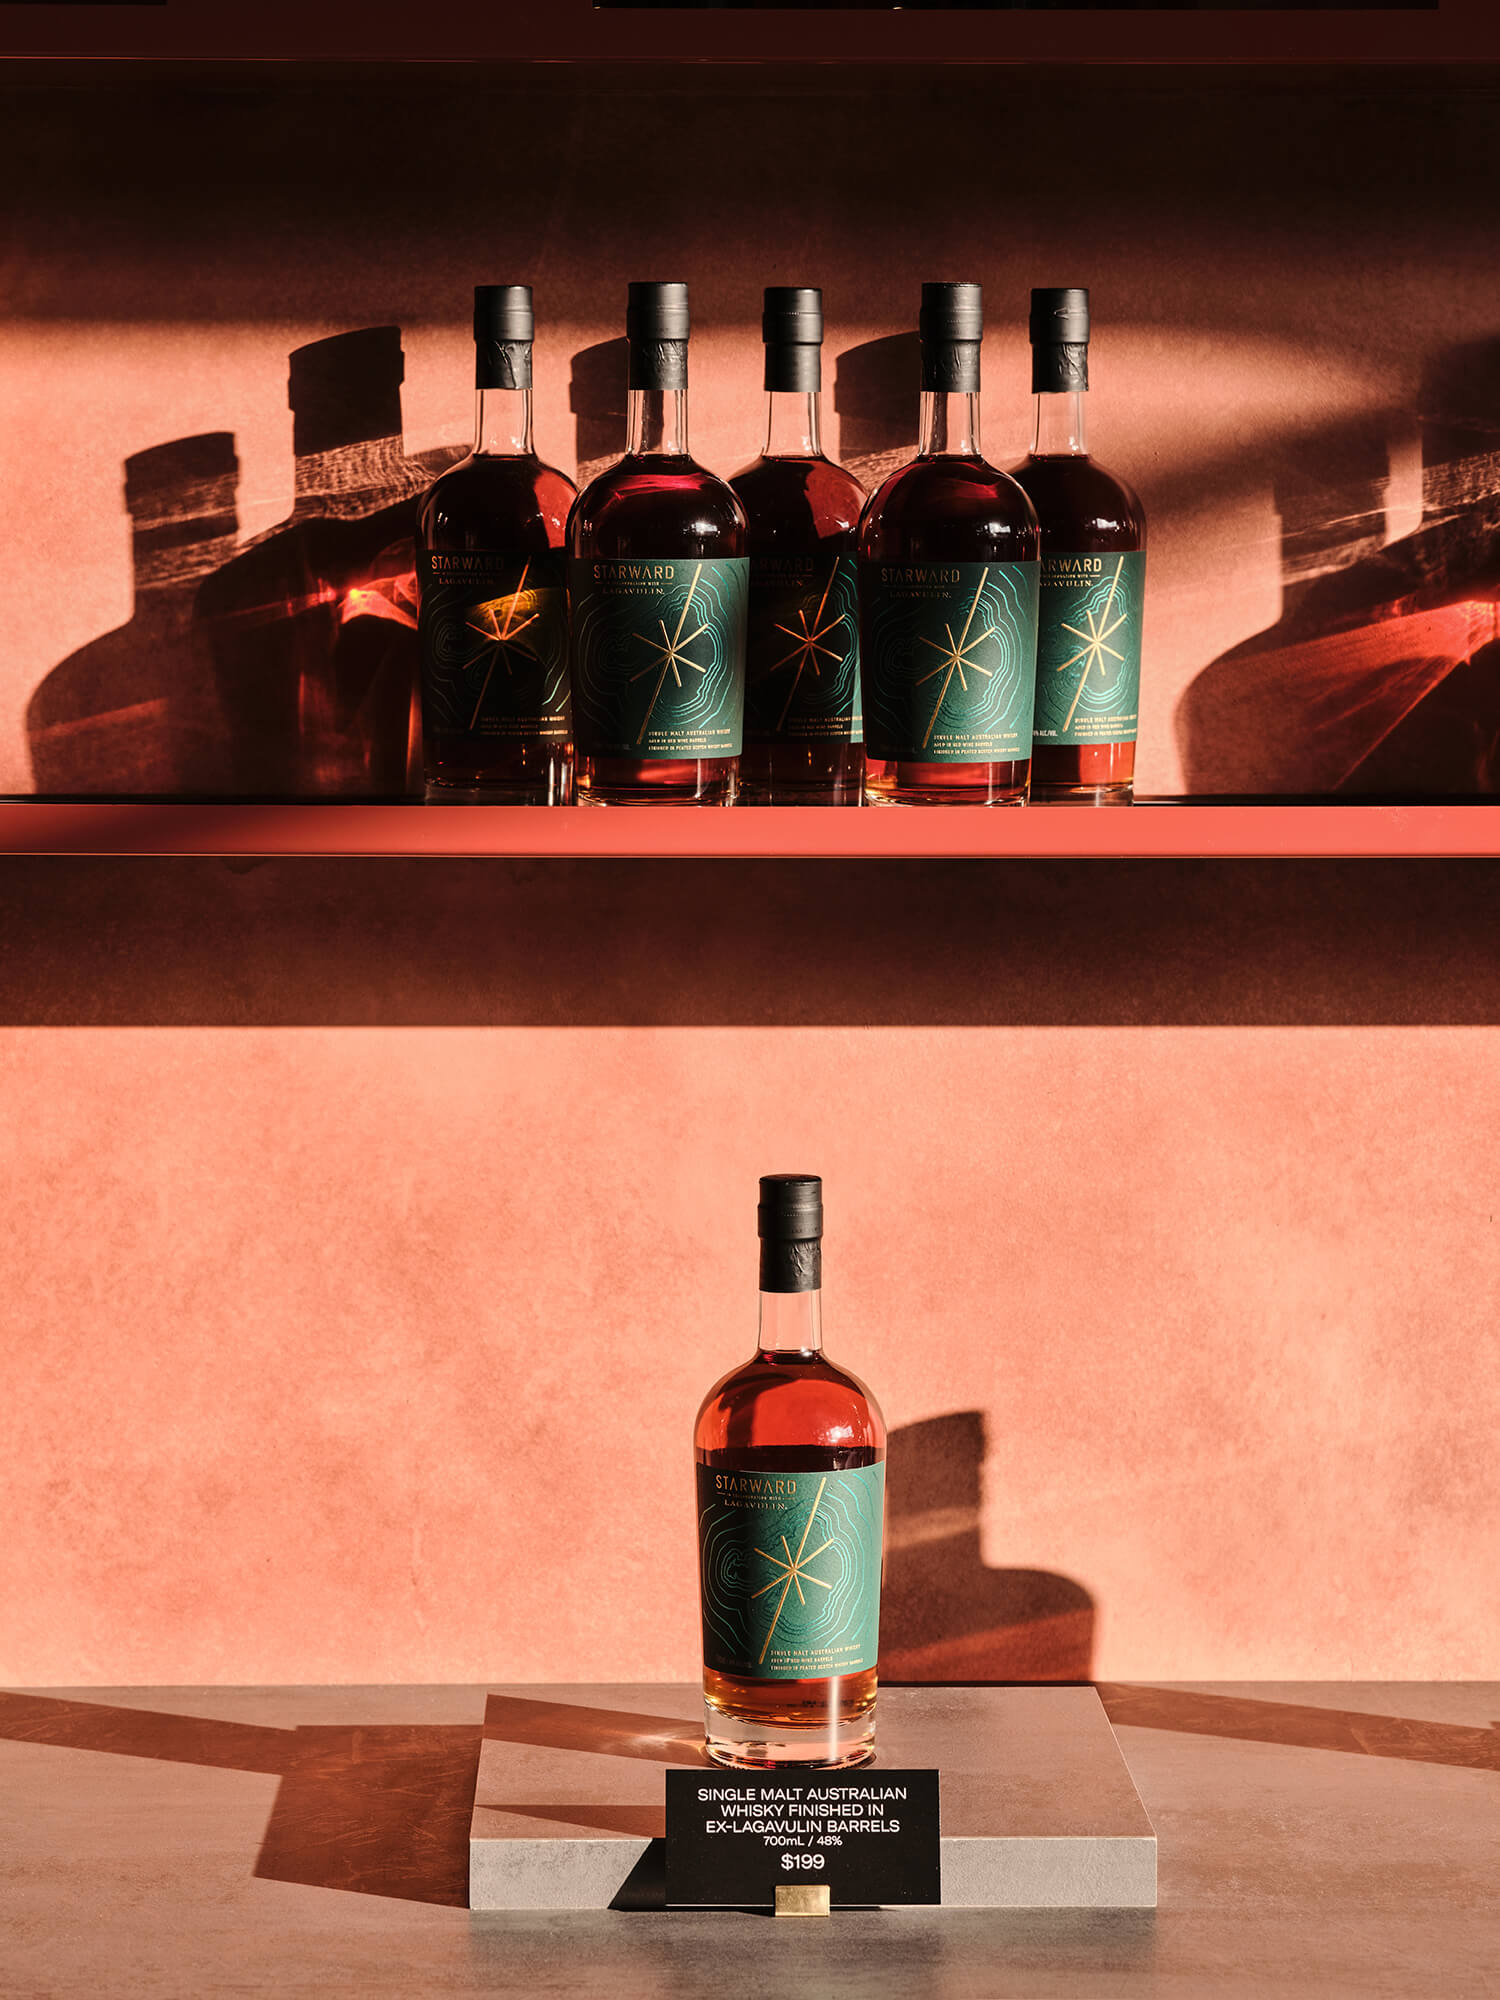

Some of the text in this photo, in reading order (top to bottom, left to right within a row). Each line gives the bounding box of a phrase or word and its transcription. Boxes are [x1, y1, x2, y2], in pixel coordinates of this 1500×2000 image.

[593, 564, 675, 580] STARWARD
[881, 567, 961, 583] STARWARD
[715, 1474, 798, 1494] STARWARD
[697, 1787, 907, 1801] SINGLE MALT AUSTRALIAN
[720, 1803, 884, 1817] WHISKY FINISHED IN
[706, 1820, 900, 1833] EX-LAGAVULIN BARRELS
[763, 1835, 843, 1847] 700mL / 48%
[781, 1852, 825, 1871] $199
